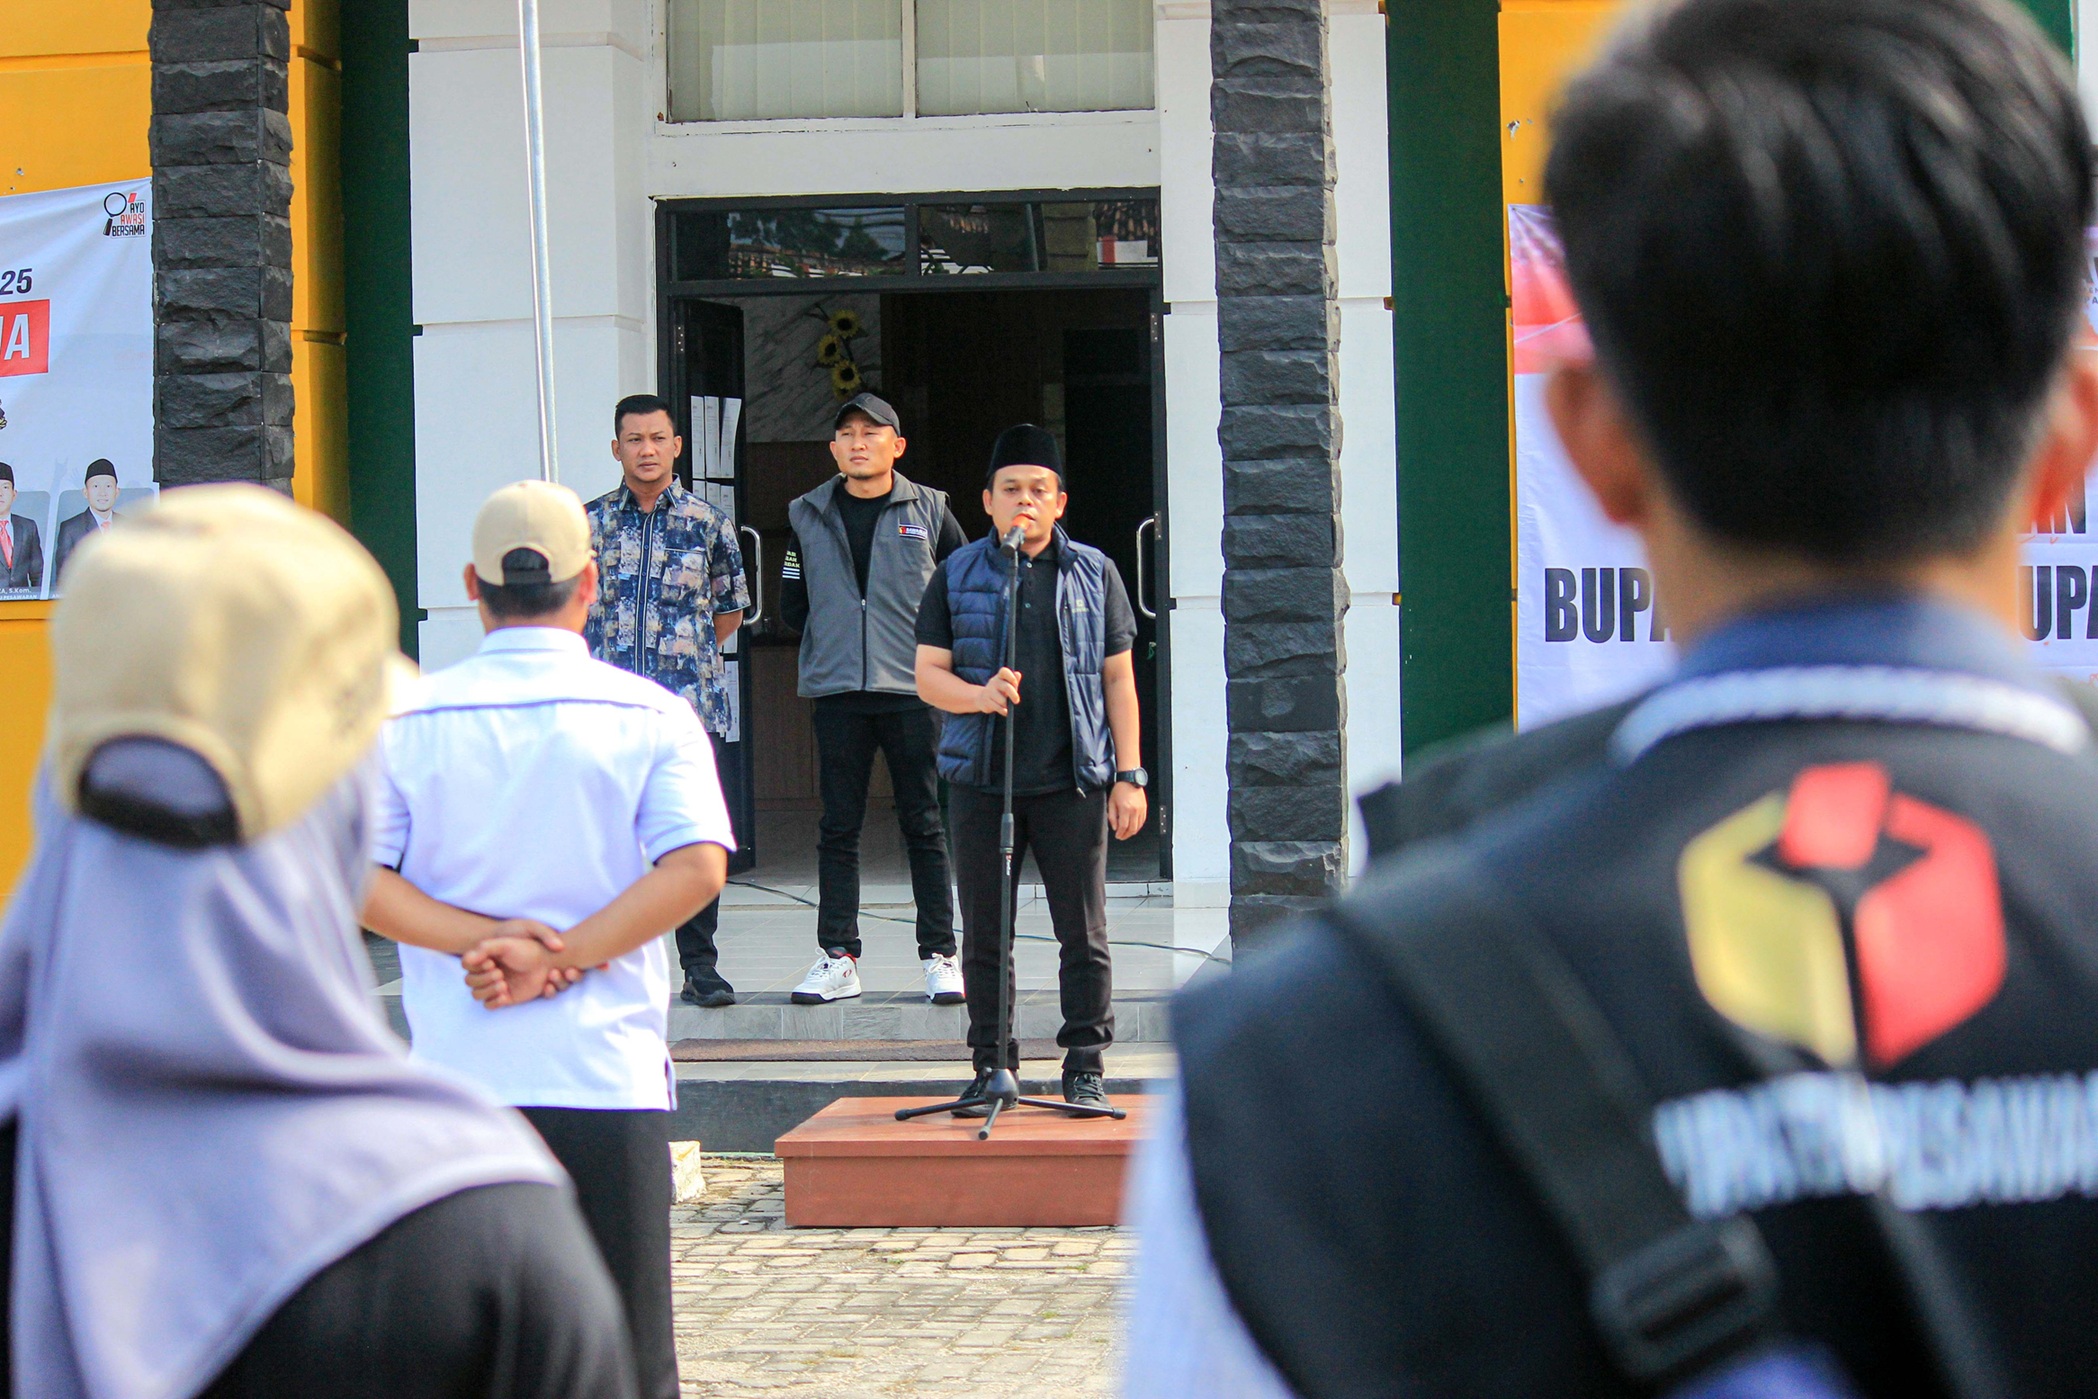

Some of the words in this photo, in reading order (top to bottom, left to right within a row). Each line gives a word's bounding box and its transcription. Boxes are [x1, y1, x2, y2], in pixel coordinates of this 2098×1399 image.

[130, 202, 145, 213] AYO
[120, 213, 145, 224] AWASI
[111, 224, 145, 236] BERSAMA
[0, 268, 33, 295] 25
[0, 313, 31, 360] A
